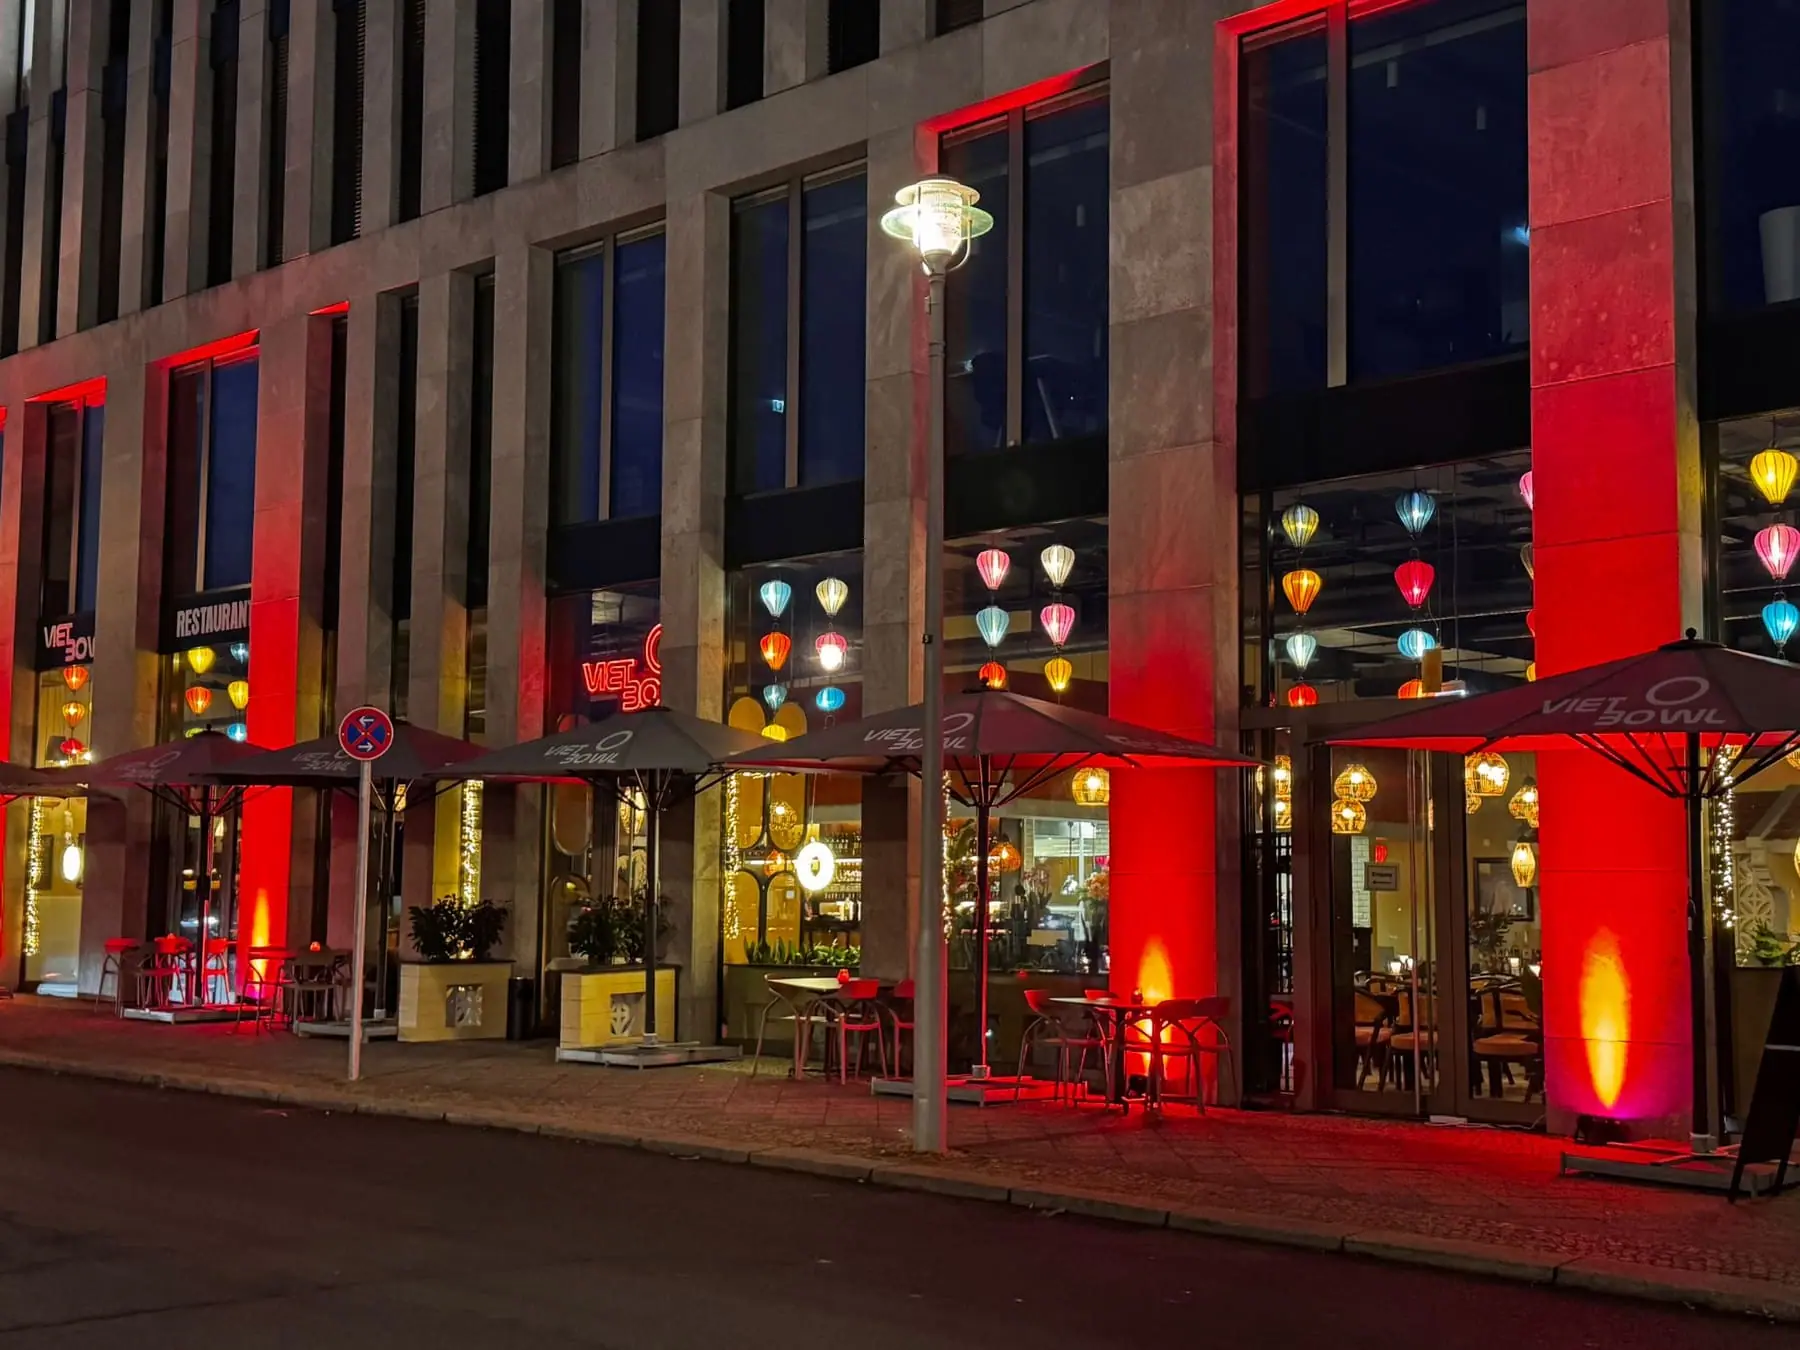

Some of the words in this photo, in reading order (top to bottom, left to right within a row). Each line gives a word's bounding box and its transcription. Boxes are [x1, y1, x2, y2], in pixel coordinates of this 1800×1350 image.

[176, 600, 251, 638] RESTAURAN
[43, 622, 73, 648] VIET
[582, 658, 636, 692] VIET
[1542, 697, 1627, 714] VIET
[864, 728, 920, 741] VIET
[544, 744, 588, 756] VIET
